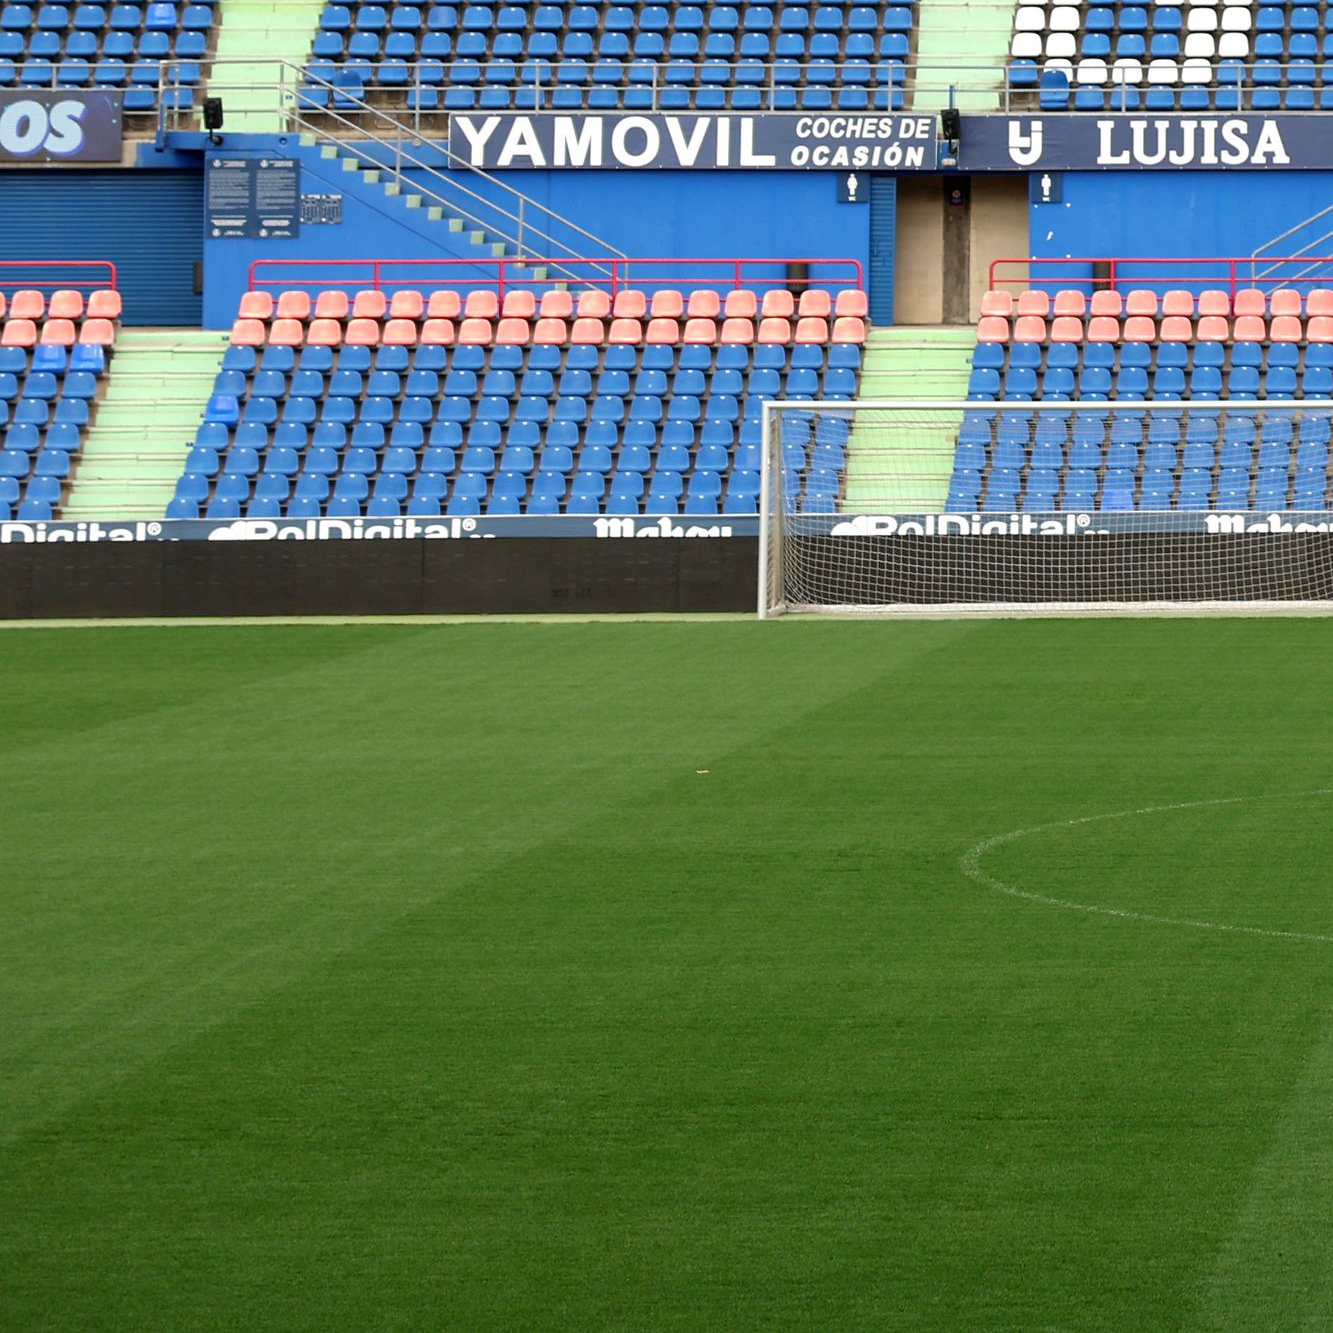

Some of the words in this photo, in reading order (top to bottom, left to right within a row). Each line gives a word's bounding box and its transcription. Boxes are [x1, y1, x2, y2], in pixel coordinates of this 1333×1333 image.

[455, 115, 777, 167] YAMOVIL
[795, 116, 893, 139] COCHES
[900, 117, 931, 140] DE
[790, 141, 925, 167] OCASIÓN
[1096, 120, 1291, 166] LUJISA
